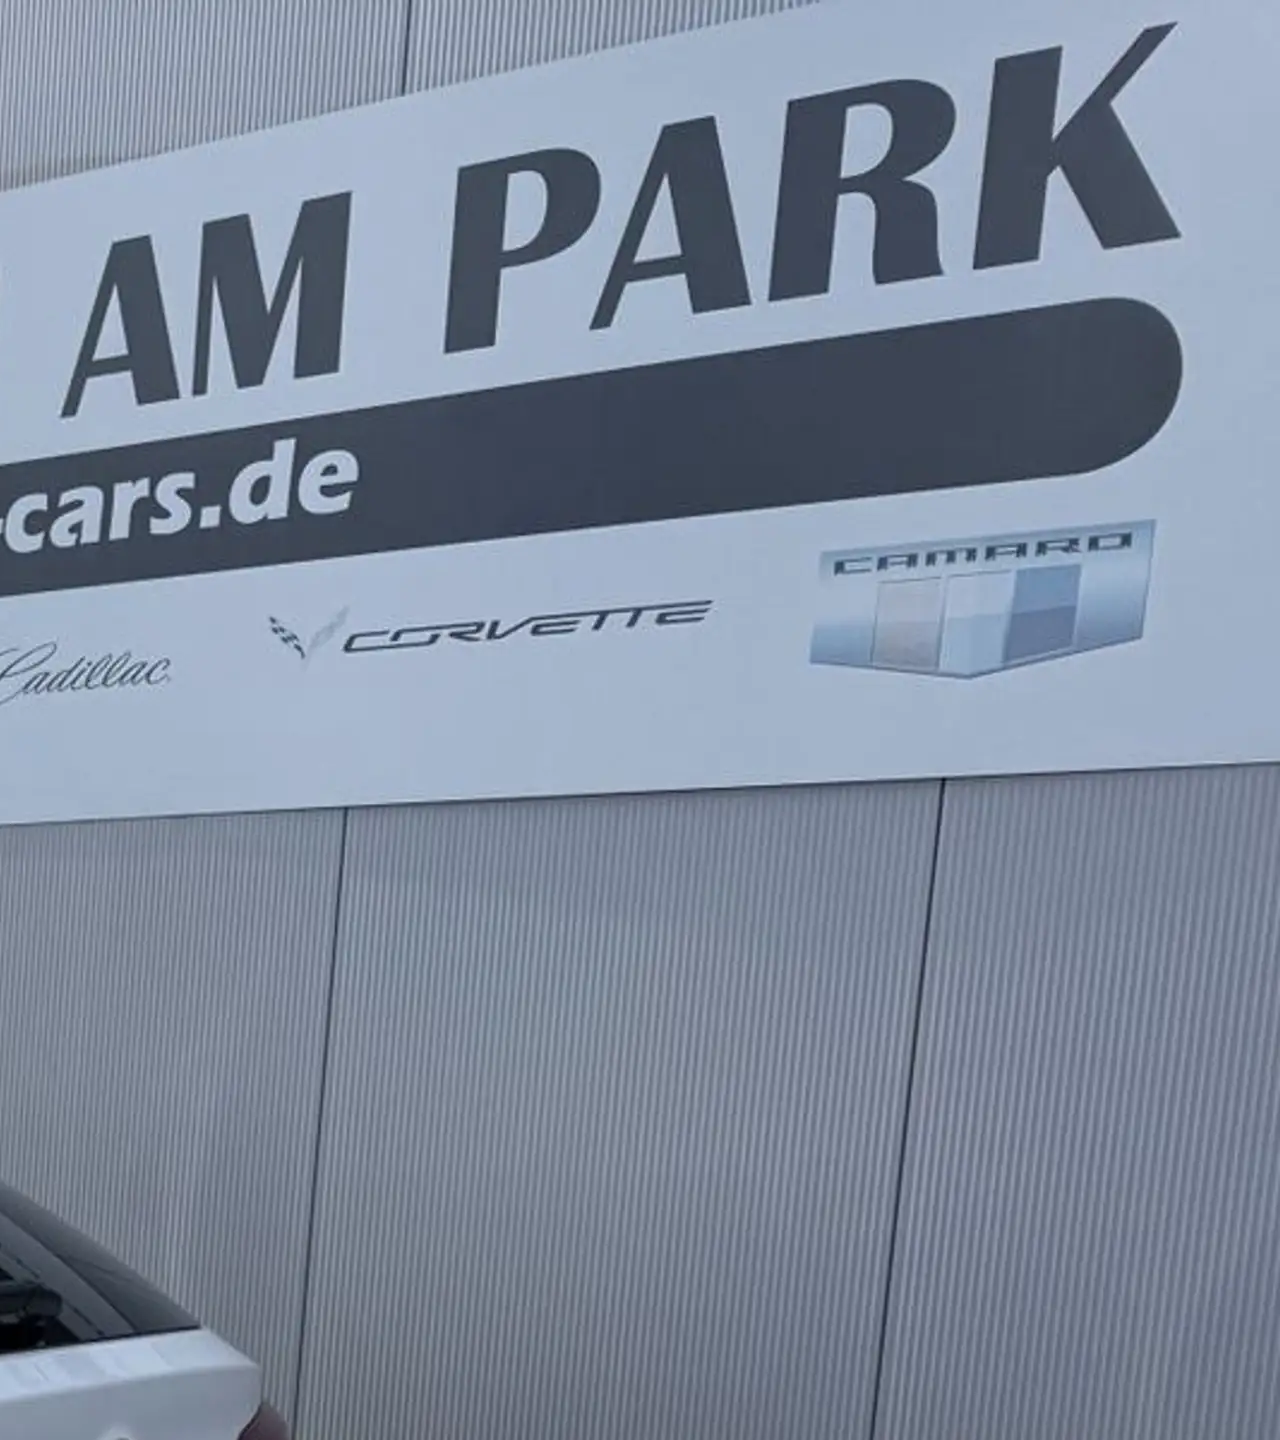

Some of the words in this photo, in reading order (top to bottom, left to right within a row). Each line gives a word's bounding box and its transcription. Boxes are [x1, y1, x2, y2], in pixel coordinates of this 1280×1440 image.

[60, 190, 353, 419] AM
[443, 22, 1182, 354] PARK
[832, 531, 1132, 576] CAMARO
[343, 600, 714, 654] CORVETTE
